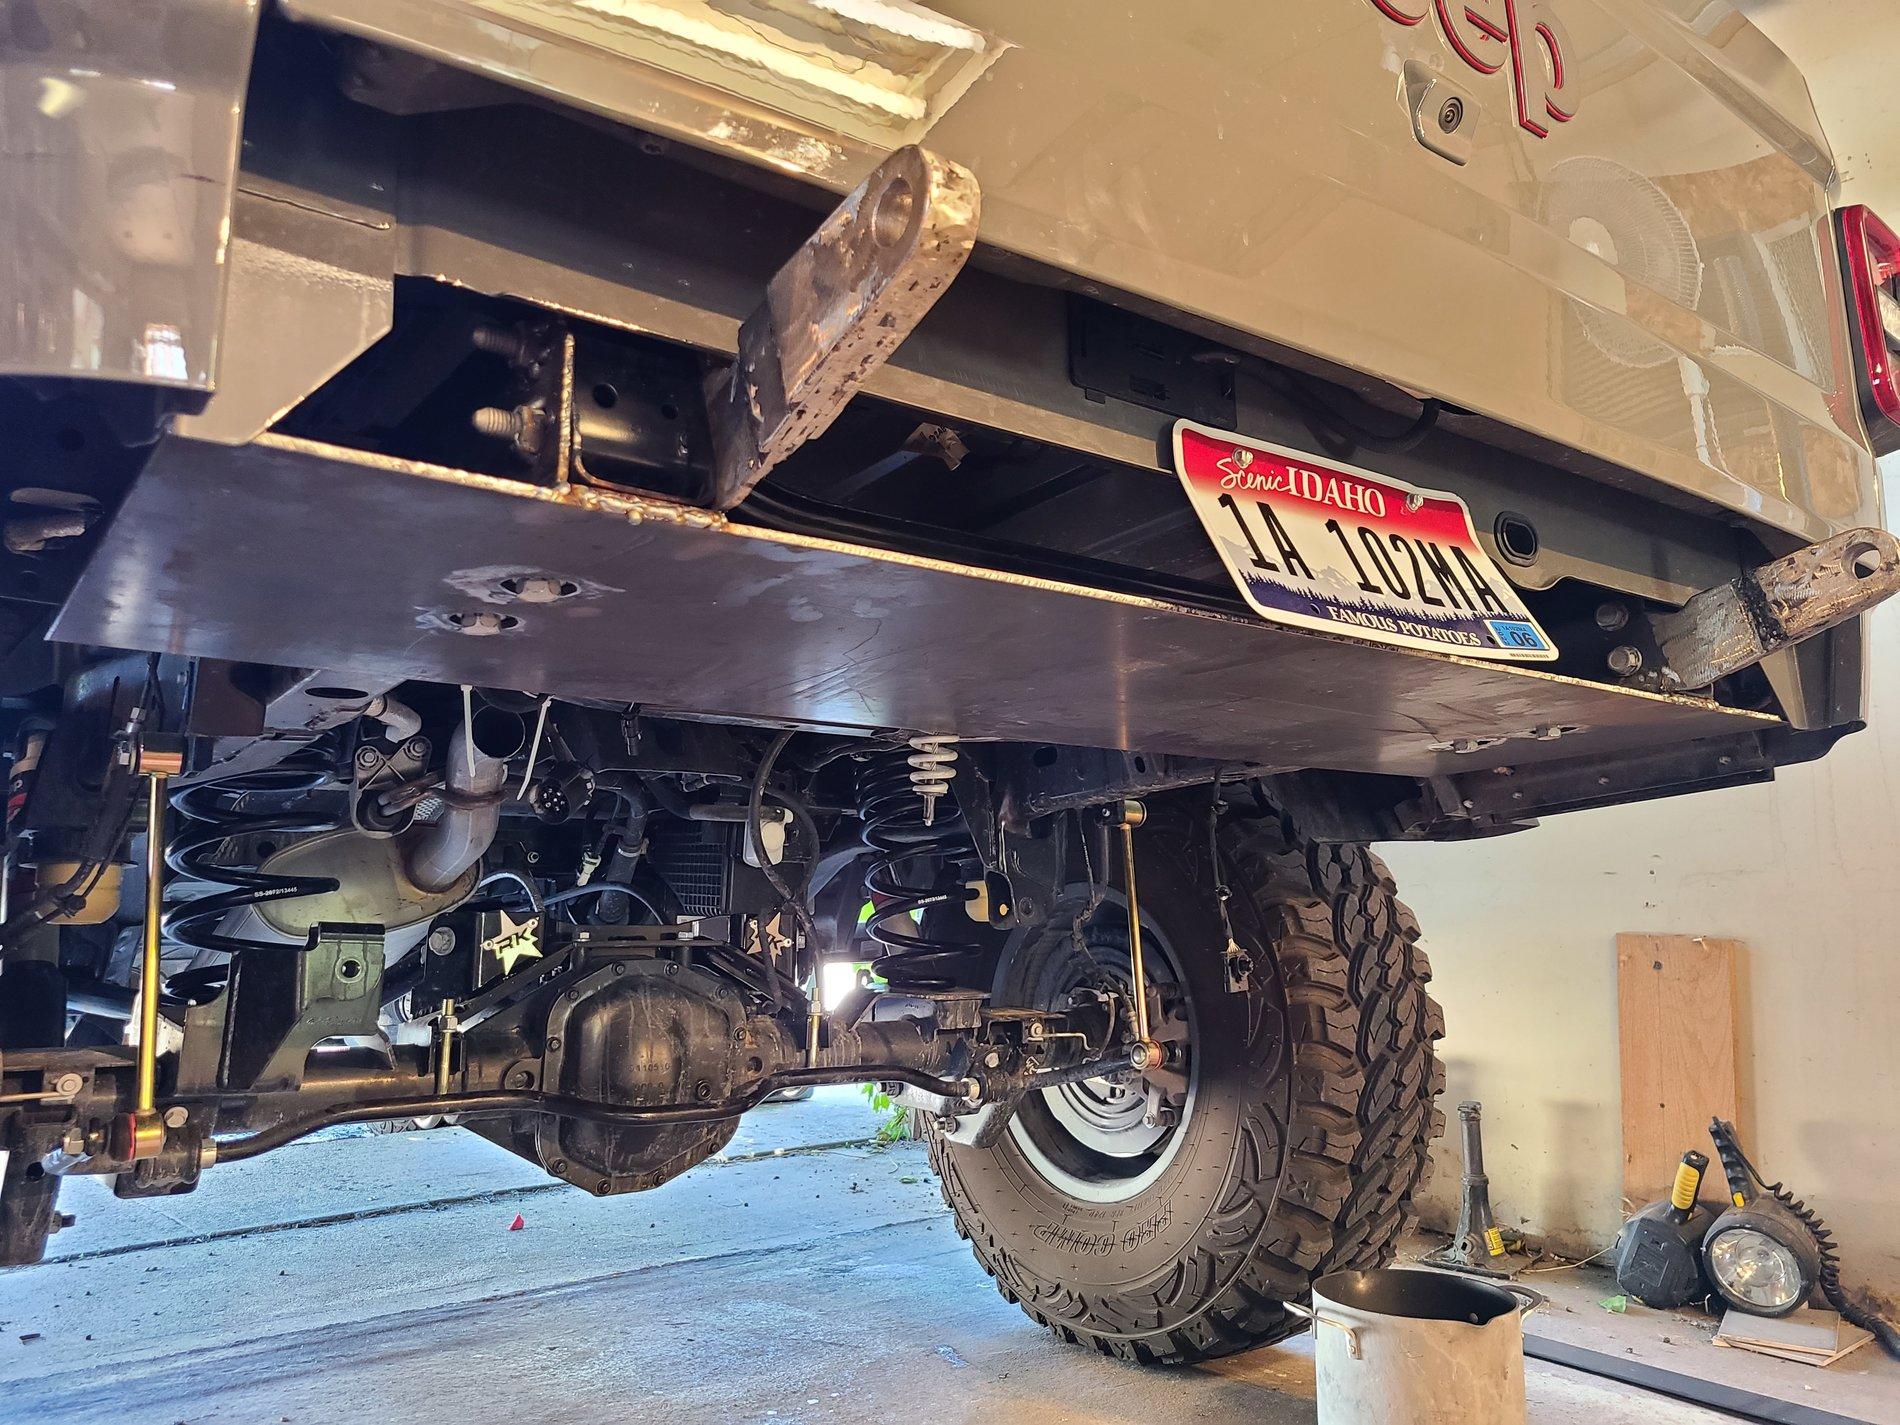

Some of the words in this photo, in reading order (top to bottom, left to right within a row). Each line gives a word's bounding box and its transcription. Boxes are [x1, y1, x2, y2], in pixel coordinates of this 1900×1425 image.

[1216, 458, 1291, 491] Scenic
[1286, 466, 1386, 518] IDAHO
[1218, 493, 1315, 580] 1A
[1325, 519, 1508, 614] 102MA
[1326, 605, 1398, 633] FAMOUS
[1398, 620, 1482, 647] POTATOES
[1510, 631, 1538, 647] 06
